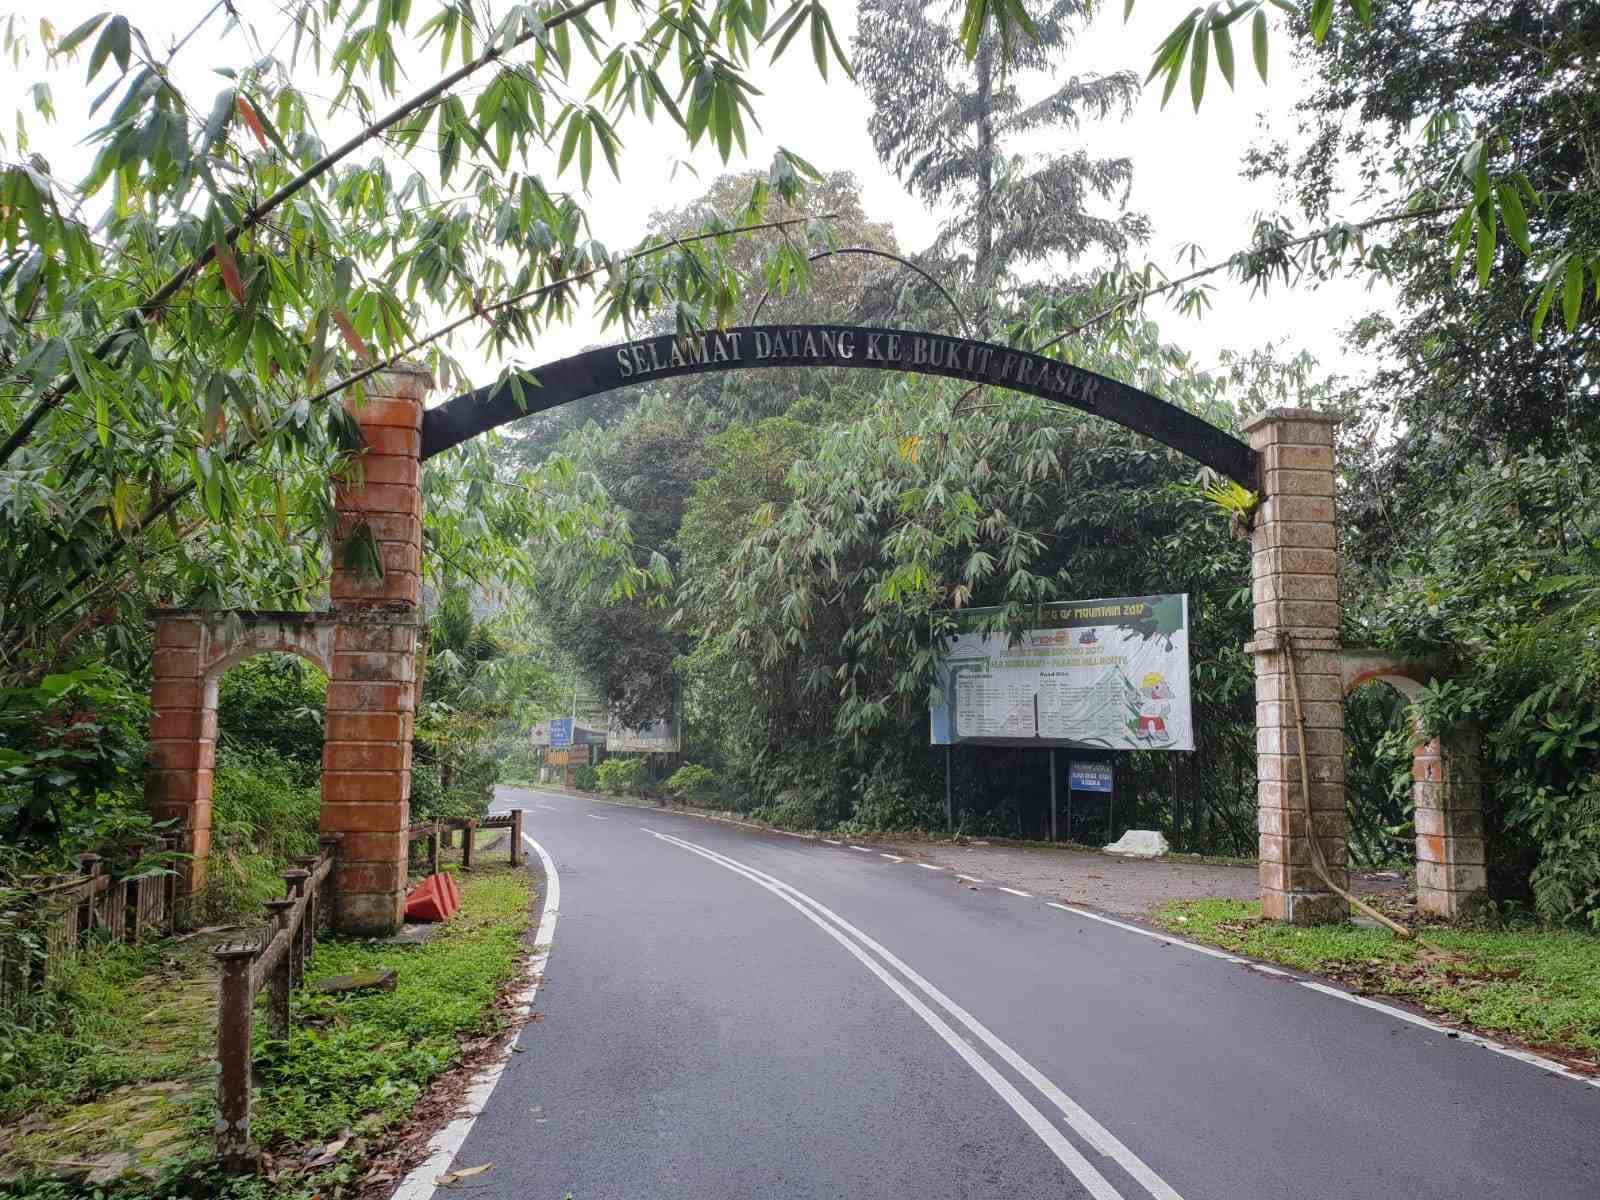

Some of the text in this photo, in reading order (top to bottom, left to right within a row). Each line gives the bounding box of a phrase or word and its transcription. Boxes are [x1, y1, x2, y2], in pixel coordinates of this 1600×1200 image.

[616, 330, 1101, 405] SELAMAT DATANG KE BUKIT FRASER
[1074, 604, 1121, 618] MOUNTAIN
[1123, 602, 1145, 616] 2017
